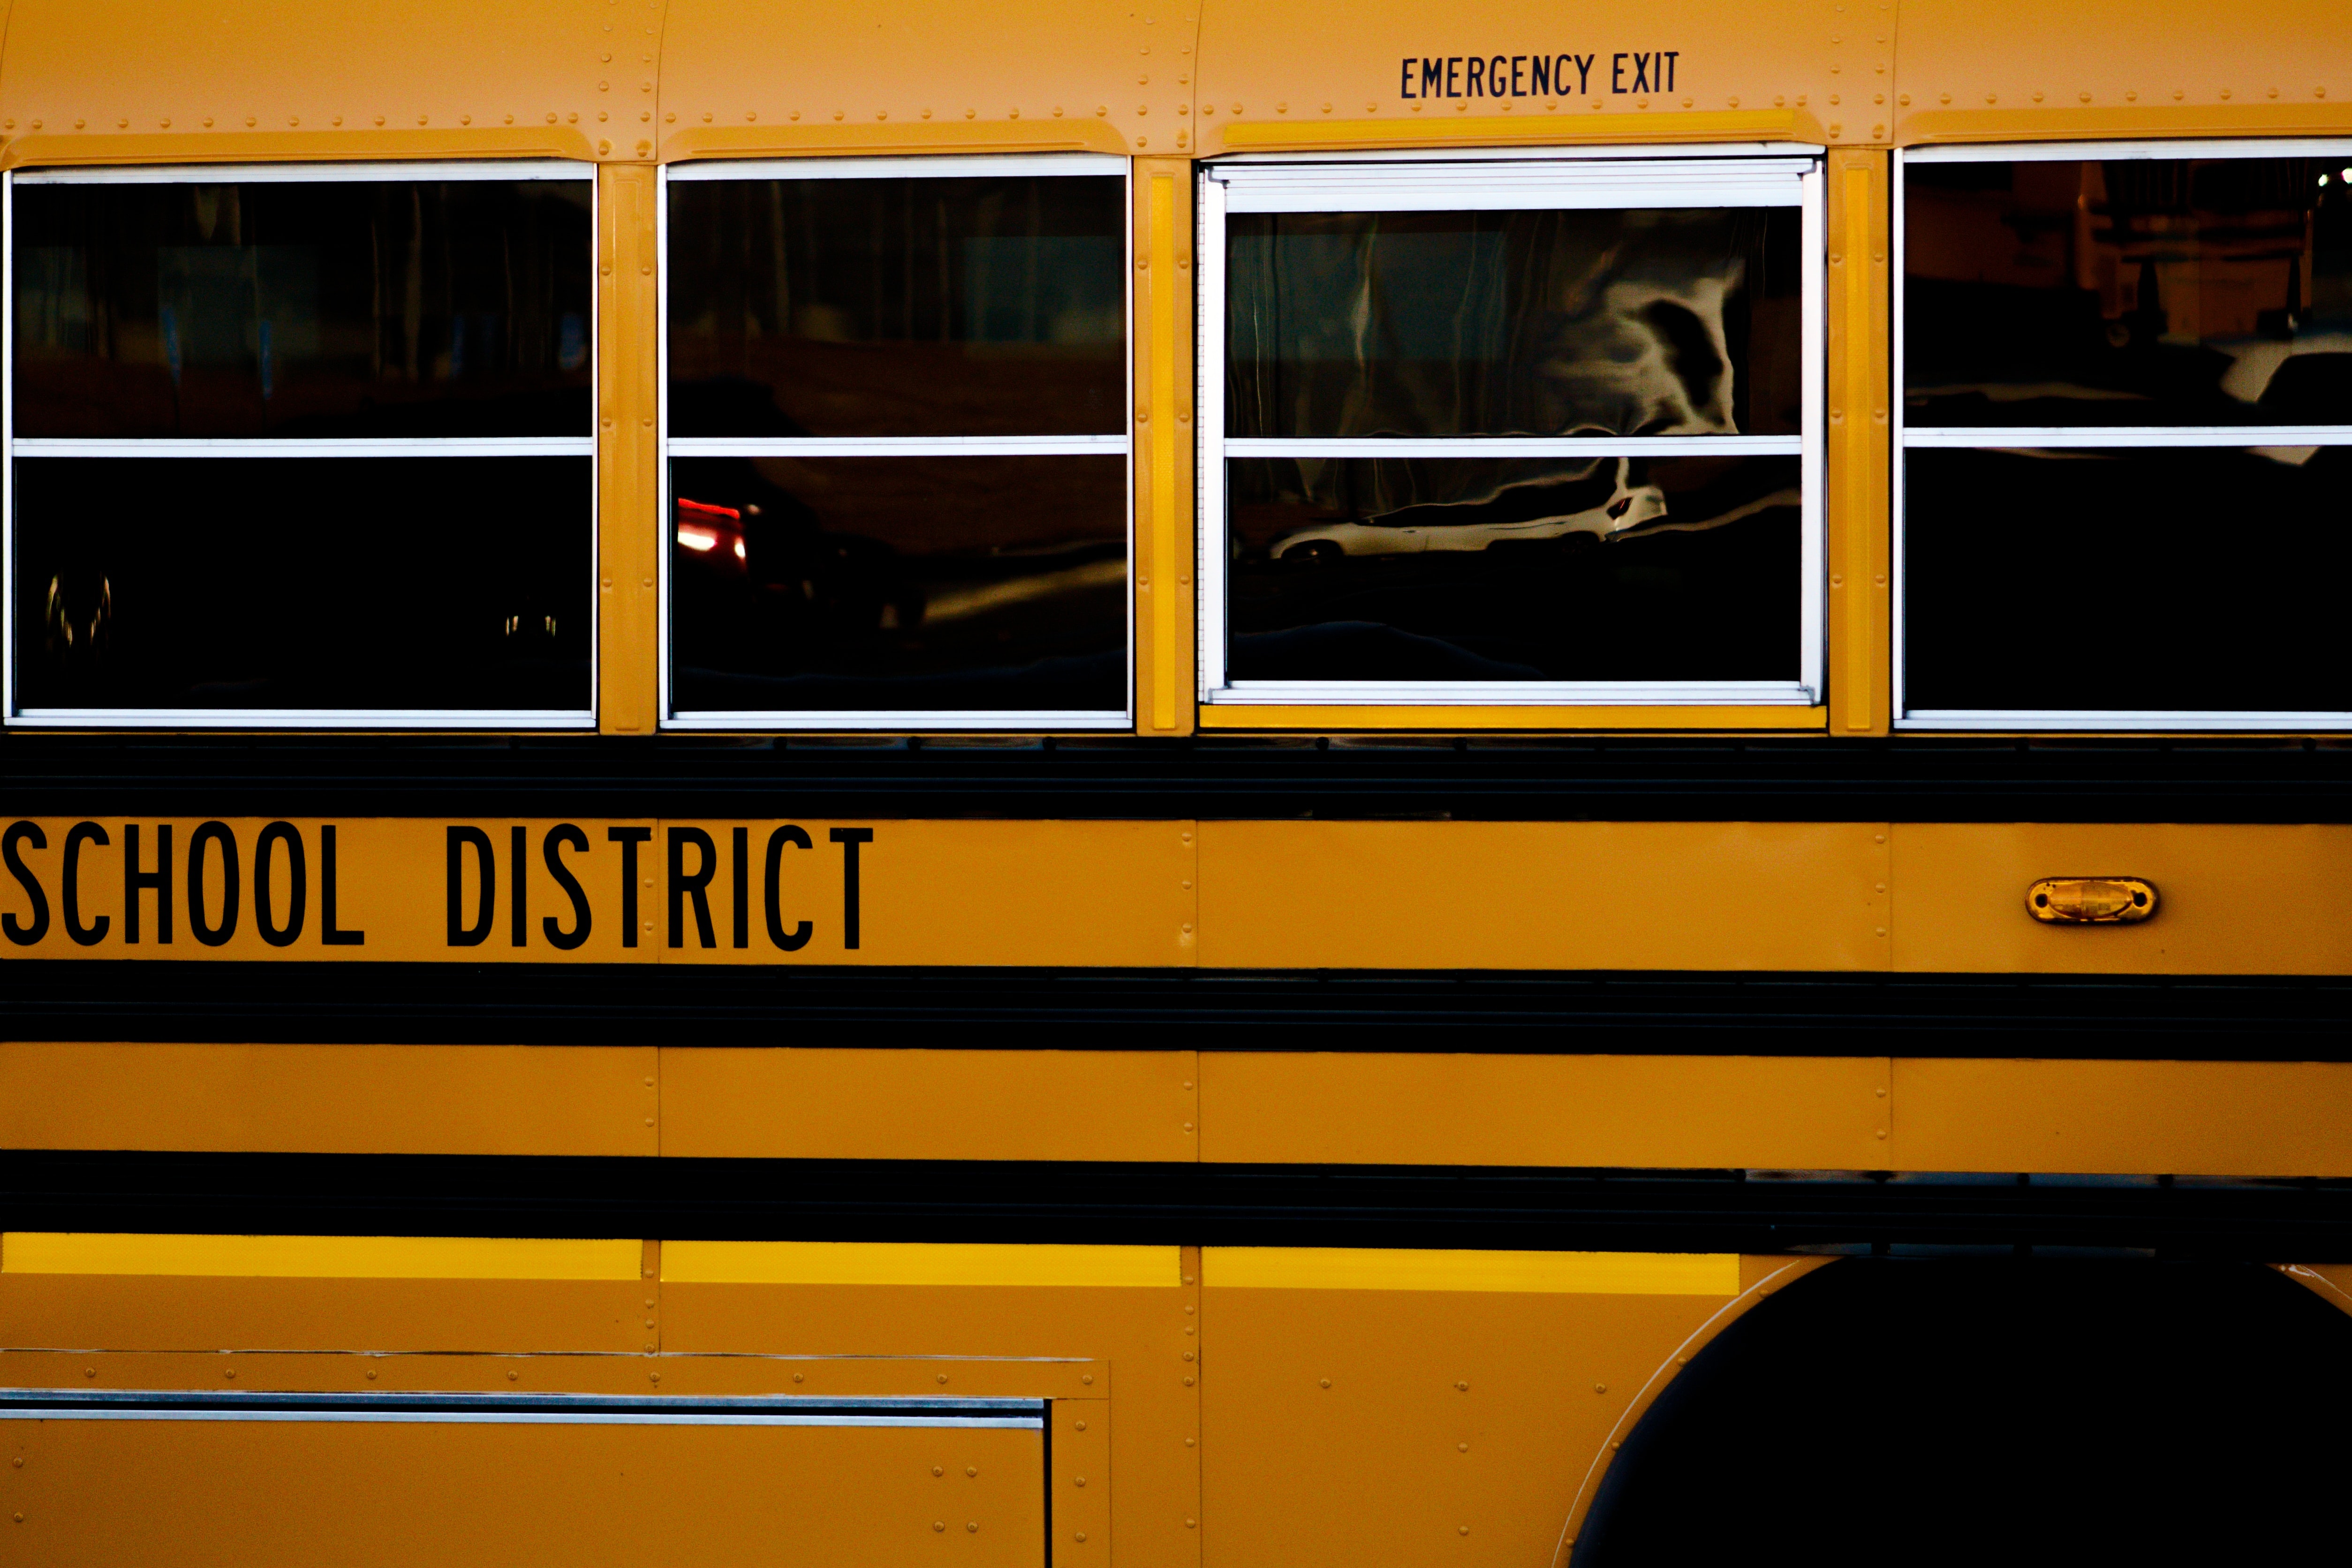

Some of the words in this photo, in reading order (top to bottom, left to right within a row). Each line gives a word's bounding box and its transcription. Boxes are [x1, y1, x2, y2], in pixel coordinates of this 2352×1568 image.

[1401, 54, 1596, 98] EMERGENCY
[1611, 52, 1679, 94] EXIT
[1, 820, 365, 947] SCHOOL
[446, 823, 874, 952] DISTRICT
